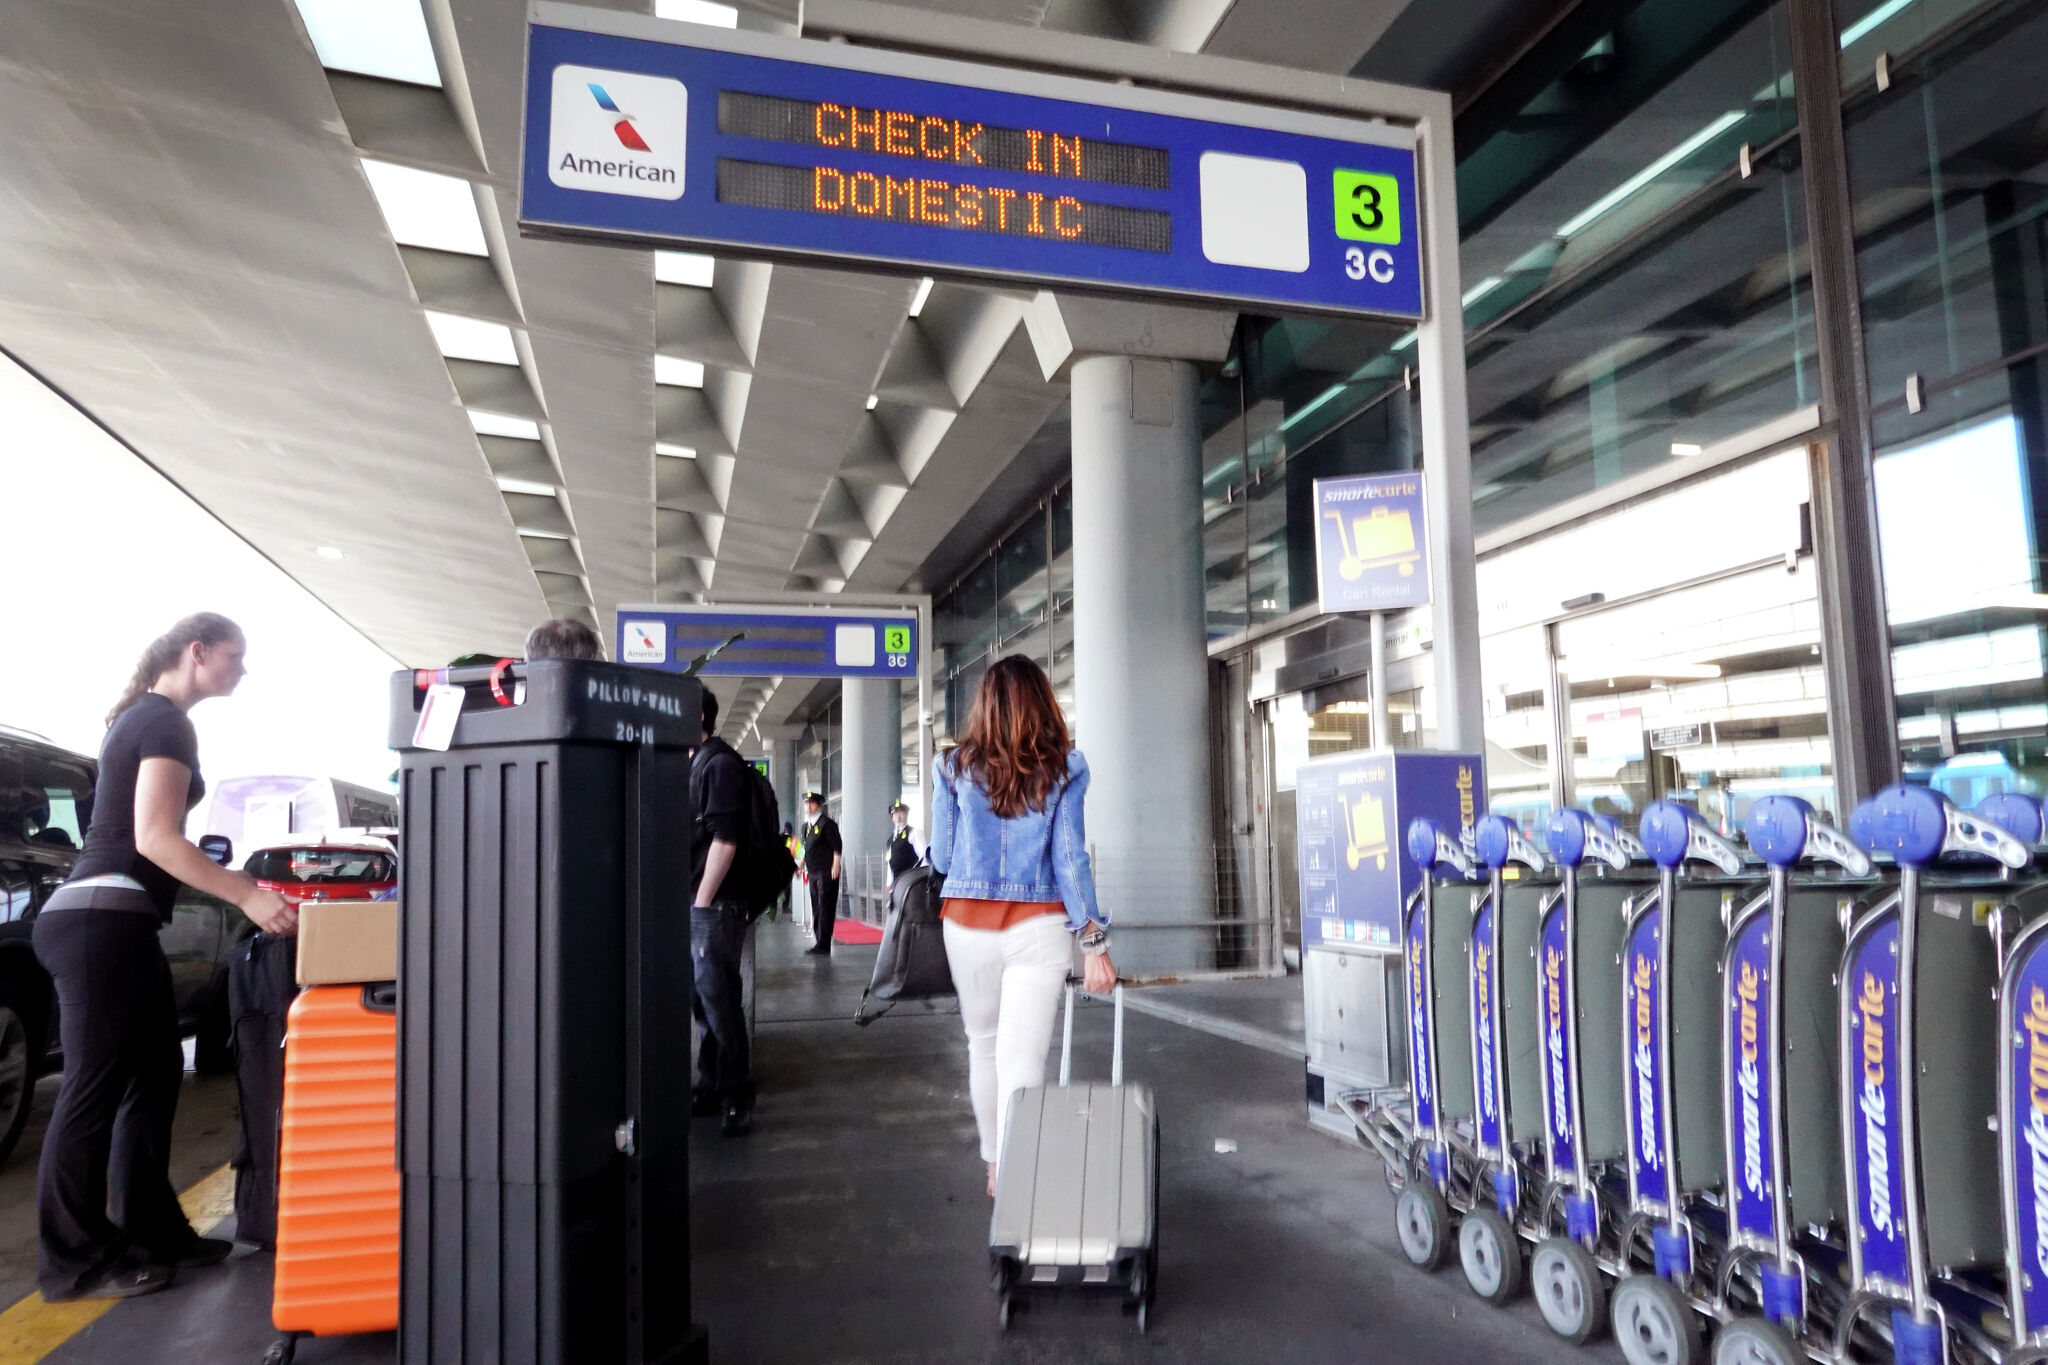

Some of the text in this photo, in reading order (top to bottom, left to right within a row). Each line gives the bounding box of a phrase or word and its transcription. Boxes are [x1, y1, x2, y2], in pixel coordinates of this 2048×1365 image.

[815, 103, 1081, 177] CHECK IN
[559, 152, 676, 185] American
[815, 167, 1082, 238] DOMESTIC
[1351, 184, 1384, 231] 3
[1345, 247, 1395, 284] 3C
[627, 648, 663, 659] American
[891, 632, 904, 649] 3
[888, 654, 907, 668] 3C
